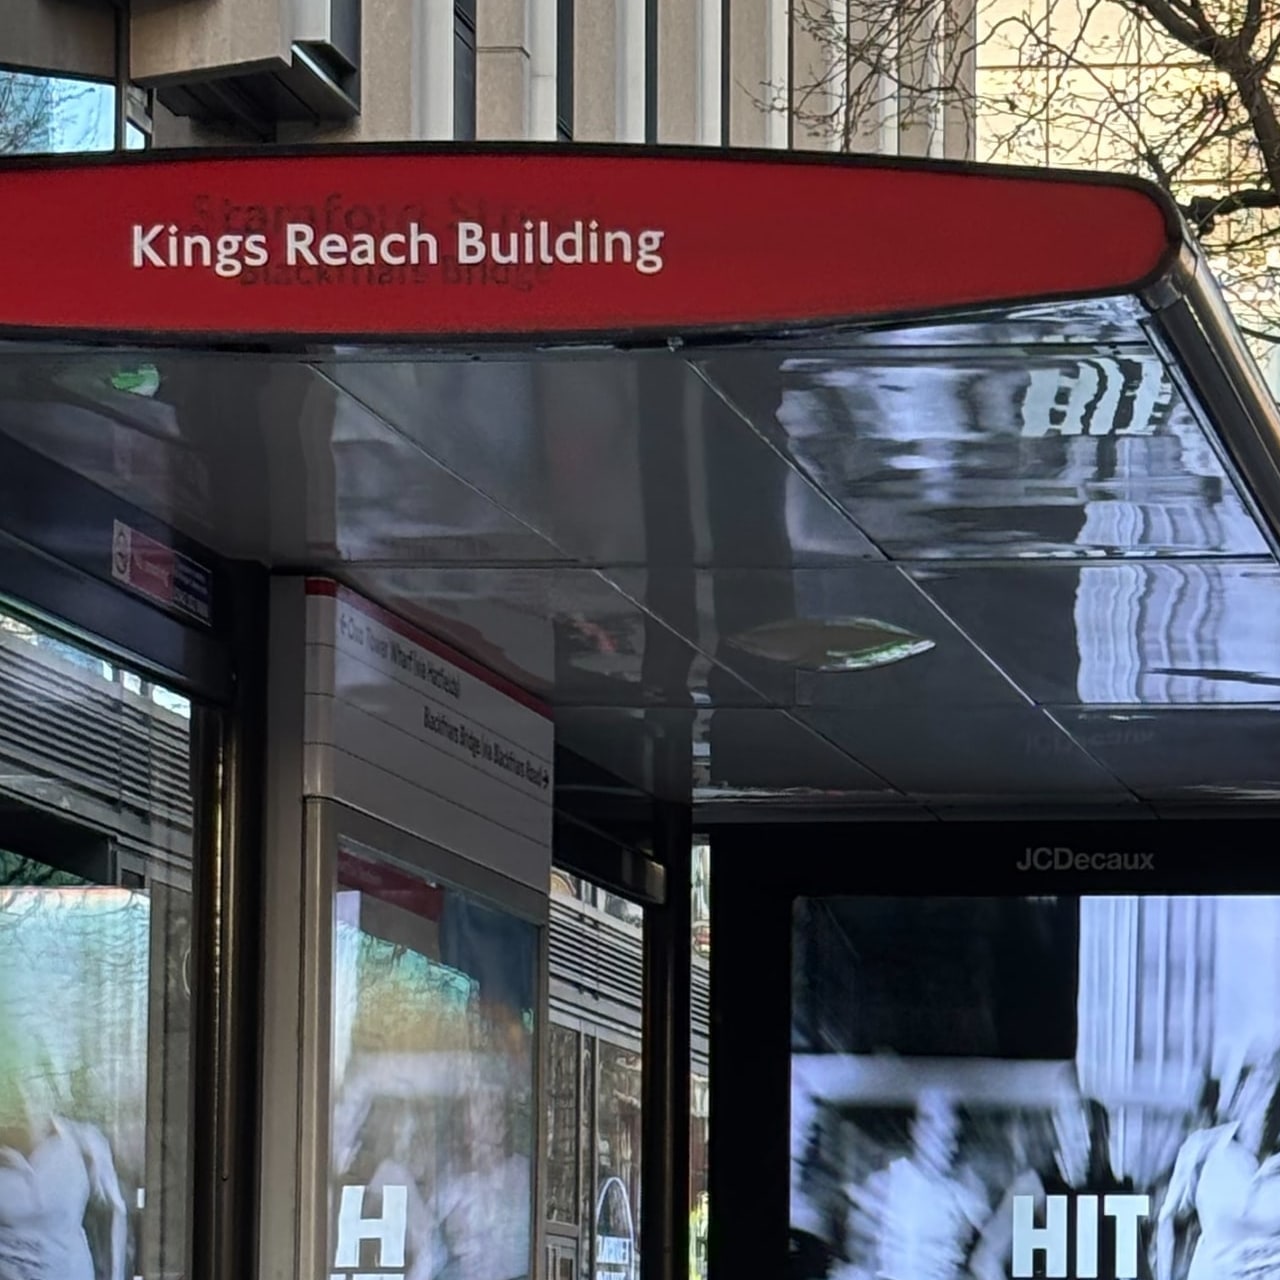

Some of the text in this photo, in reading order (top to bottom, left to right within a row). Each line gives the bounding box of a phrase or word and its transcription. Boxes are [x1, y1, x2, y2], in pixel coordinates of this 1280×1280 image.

[131, 220, 665, 277] Kings Reach Building
[1015, 847, 1156, 871] JCDecaux
[1011, 1195, 1150, 1278] HIT
